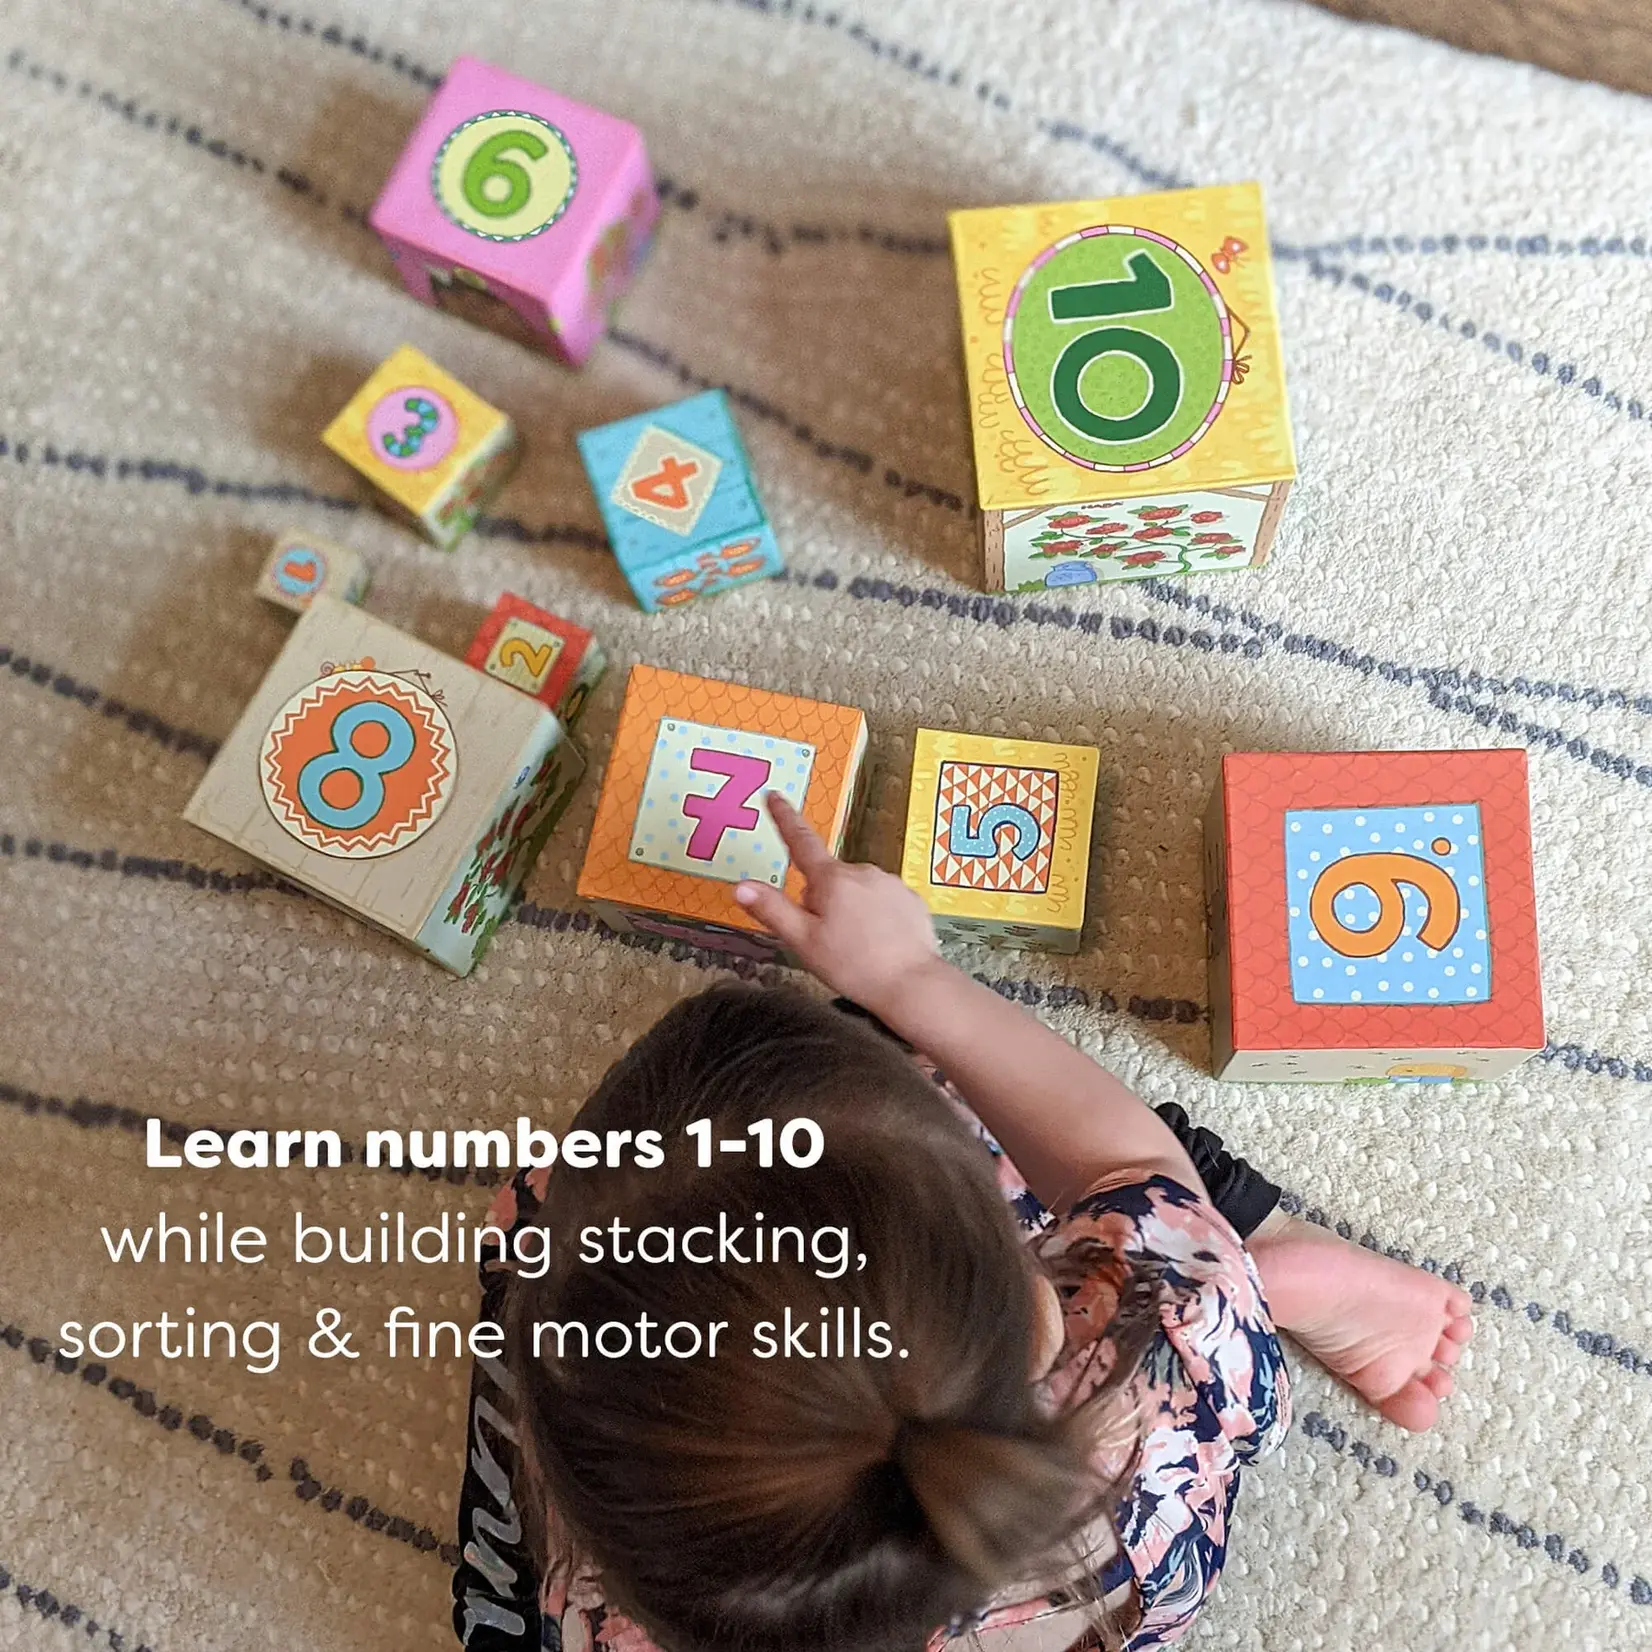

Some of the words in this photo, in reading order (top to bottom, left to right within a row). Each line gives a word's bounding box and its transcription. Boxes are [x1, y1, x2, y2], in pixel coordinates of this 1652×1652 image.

[463, 129, 548, 219] 6
[1048, 248, 1185, 445] 10
[382, 397, 439, 459] 3
[631, 454, 699, 512] 4
[499, 637, 553, 678] 2
[297, 699, 417, 831] 8
[681, 746, 772, 862] 7
[949, 801, 1042, 862] 5
